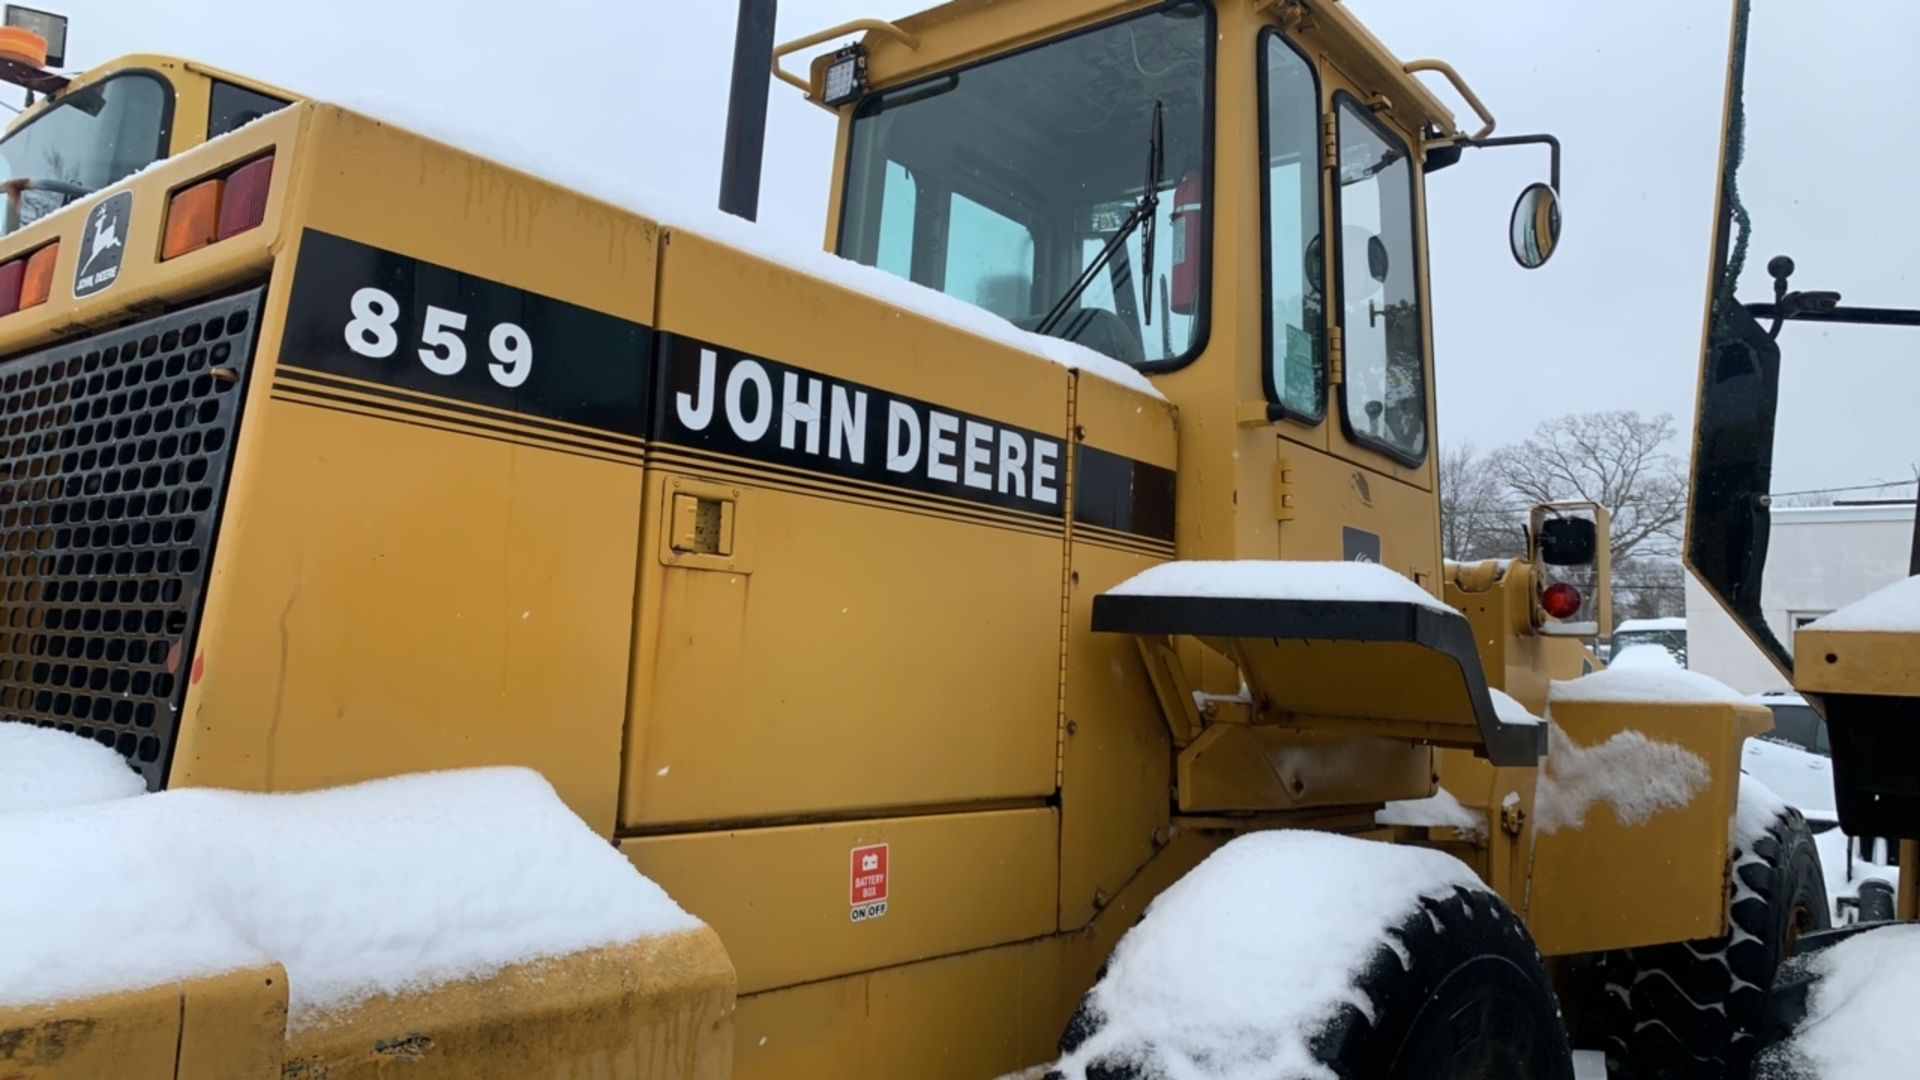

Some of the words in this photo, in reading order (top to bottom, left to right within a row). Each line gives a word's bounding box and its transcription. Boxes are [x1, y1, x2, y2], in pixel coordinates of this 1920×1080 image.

[77, 275, 94, 290] JOHN
[95, 266, 117, 283] DEERE
[344, 287, 533, 388] 859
[676, 348, 868, 464] JOHN
[886, 398, 1059, 504] DEERE
[855, 874, 884, 888] BATTERY
[863, 887, 876, 898] BOX
[852, 908, 865, 919] ON
[868, 904, 885, 916] OFF
